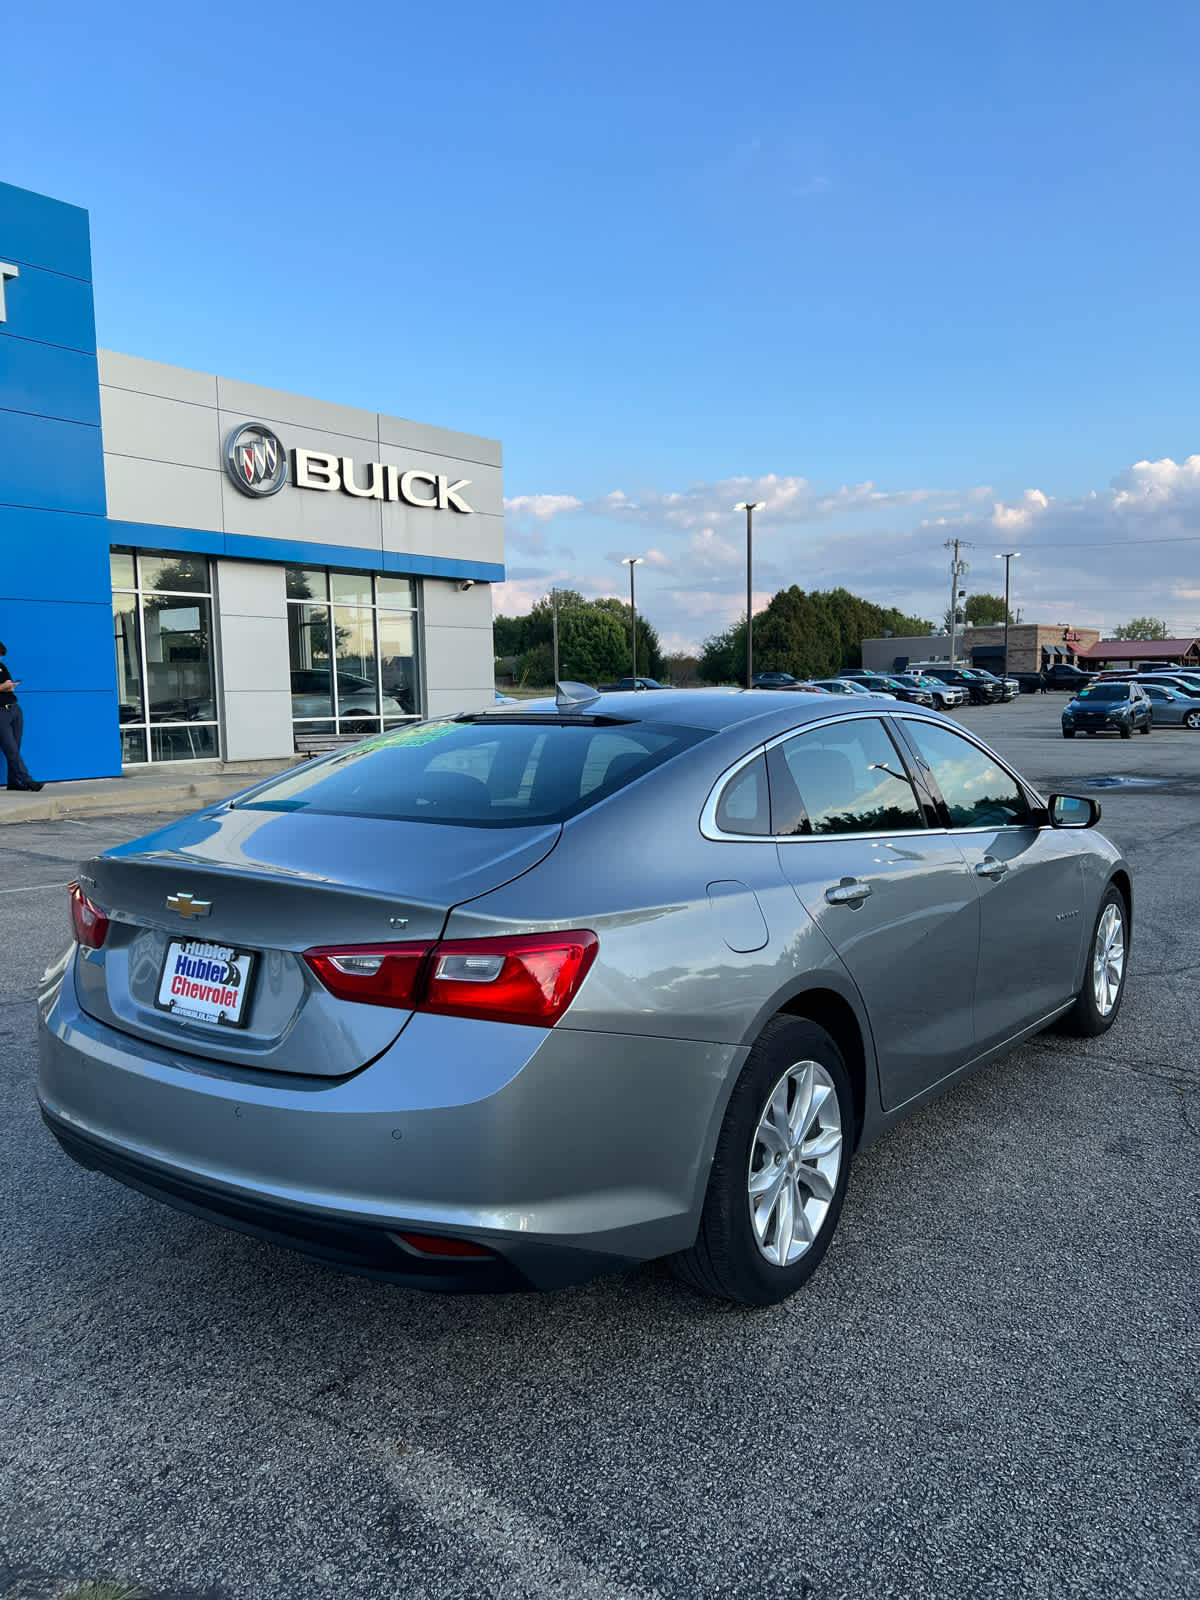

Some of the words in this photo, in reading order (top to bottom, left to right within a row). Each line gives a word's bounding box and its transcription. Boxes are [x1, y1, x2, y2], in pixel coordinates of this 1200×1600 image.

[292, 447, 474, 513] BUICK
[184, 942, 235, 962] Hubler
[174, 954, 228, 984] Hubler
[171, 975, 239, 1009] Chevrolet
